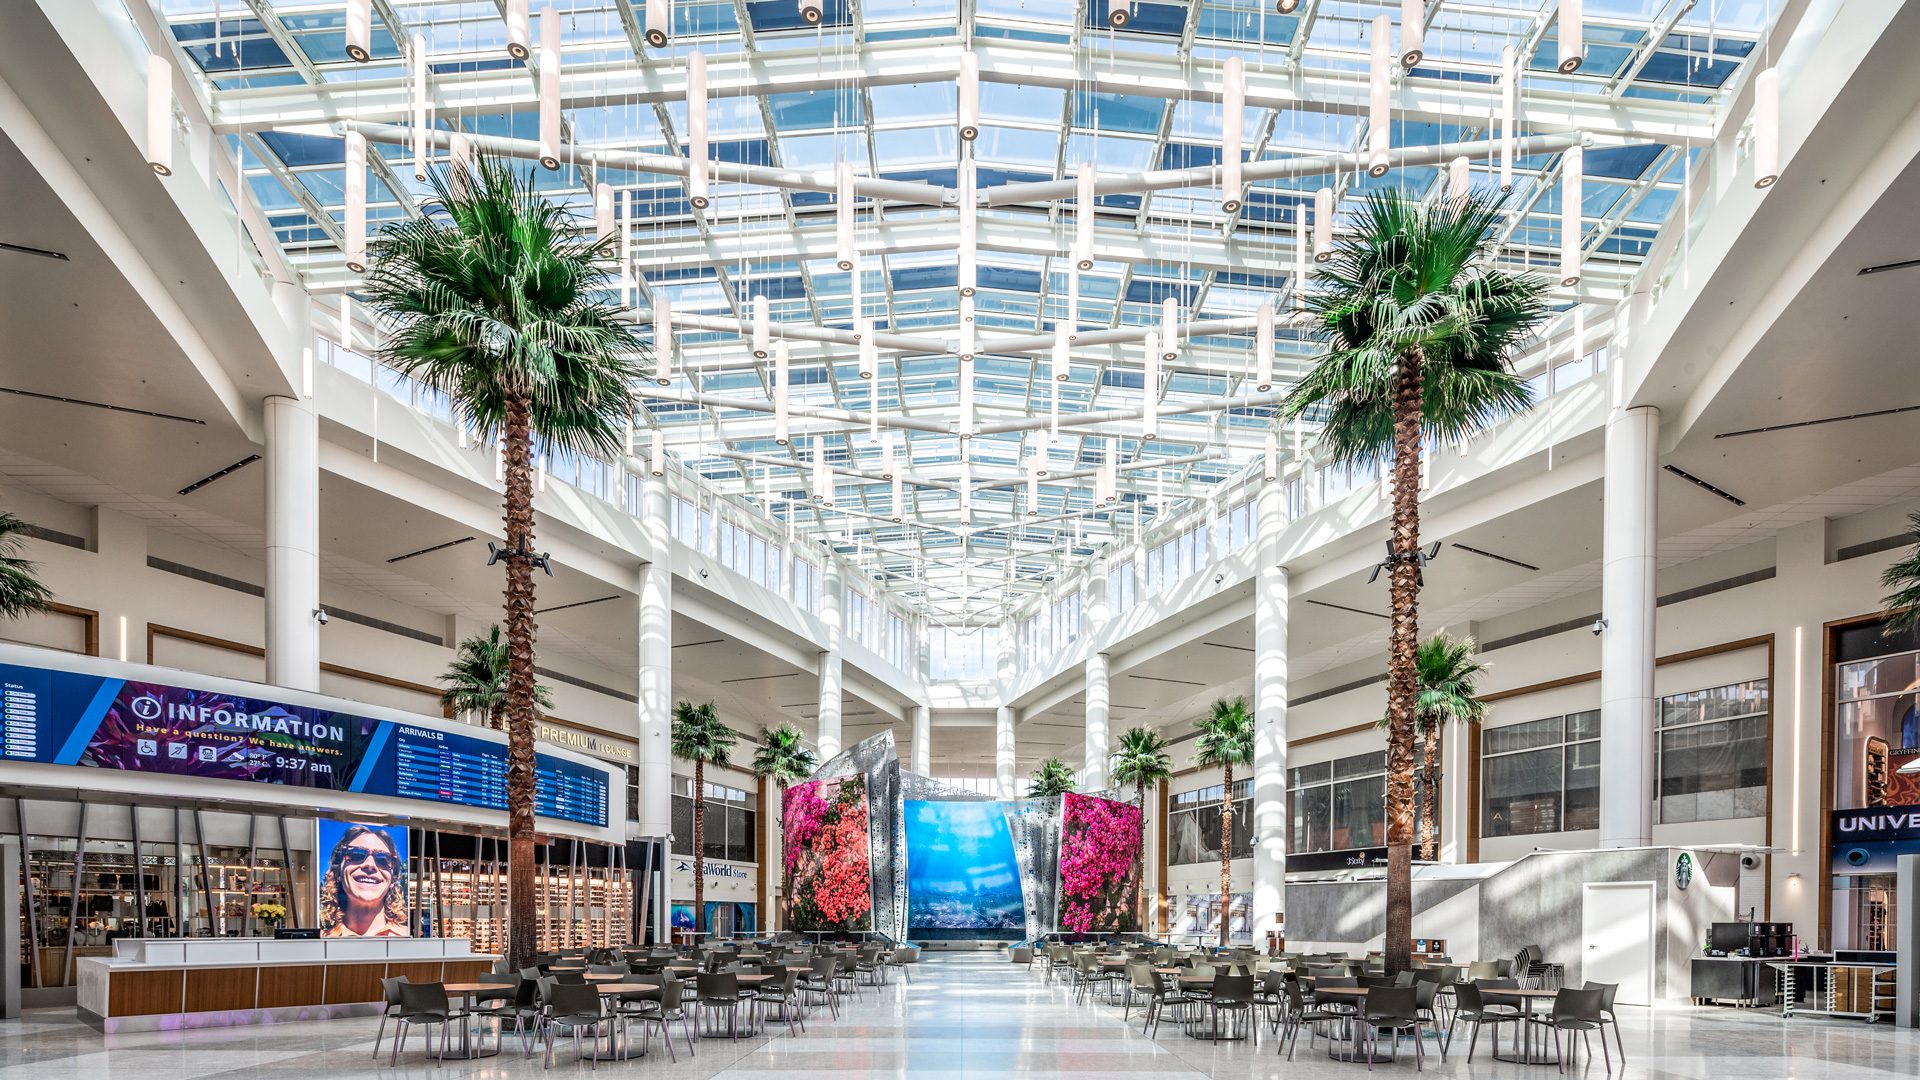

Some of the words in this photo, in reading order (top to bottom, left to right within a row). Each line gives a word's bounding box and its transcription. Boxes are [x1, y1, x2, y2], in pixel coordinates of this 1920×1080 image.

[169, 703, 344, 742] INFORMATION
[136, 723, 167, 734] Have
[173, 728, 180, 736] a
[184, 730, 244, 743] question?
[249, 737, 265, 746] We
[269, 738, 295, 750] have
[298, 745, 344, 756] answers.
[398, 726, 436, 740] ARRIVALS
[541, 726, 597, 751] PREMIUM
[600, 744, 632, 759] LOUNGE
[276, 757, 307, 770] 9:37
[310, 762, 332, 774] am
[1839, 813, 1920, 832] UNIVE
[692, 861, 732, 877] aWorld
[733, 869, 748, 879] Store
